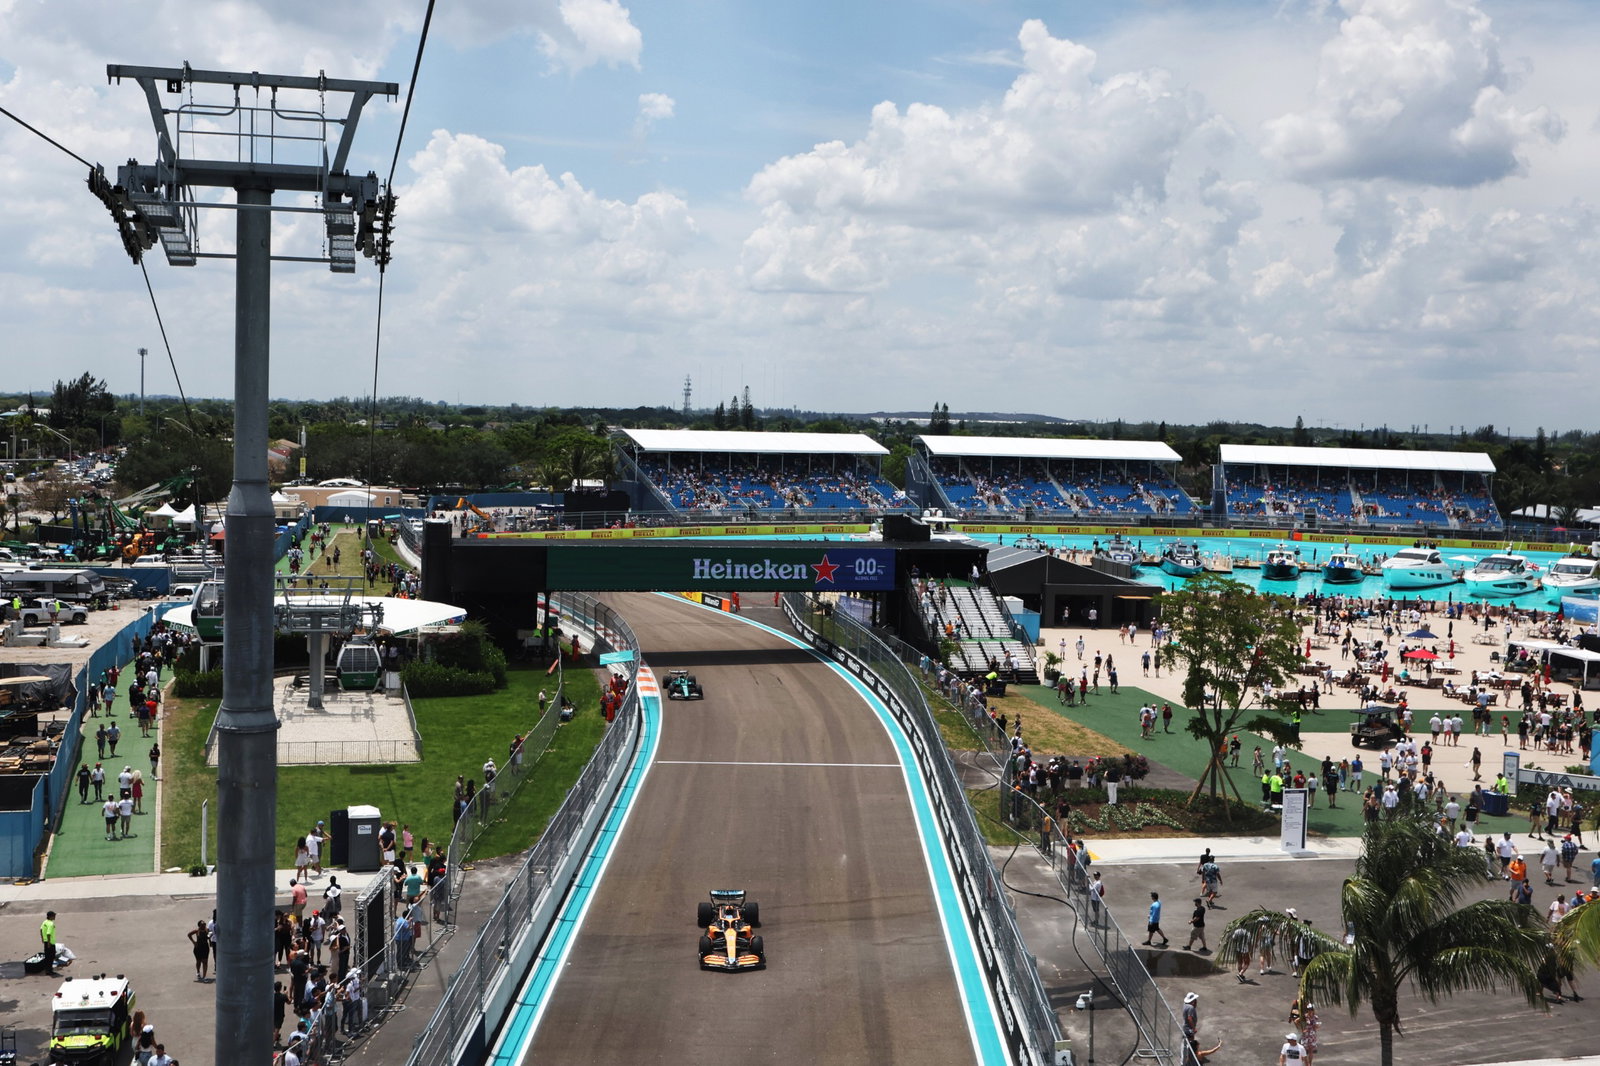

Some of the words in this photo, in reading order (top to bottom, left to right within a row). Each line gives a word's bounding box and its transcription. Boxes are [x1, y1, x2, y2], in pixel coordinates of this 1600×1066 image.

[171, 82, 178, 93] 4
[692, 558, 808, 580] Heineken
[1535, 772, 1574, 788] MIA
